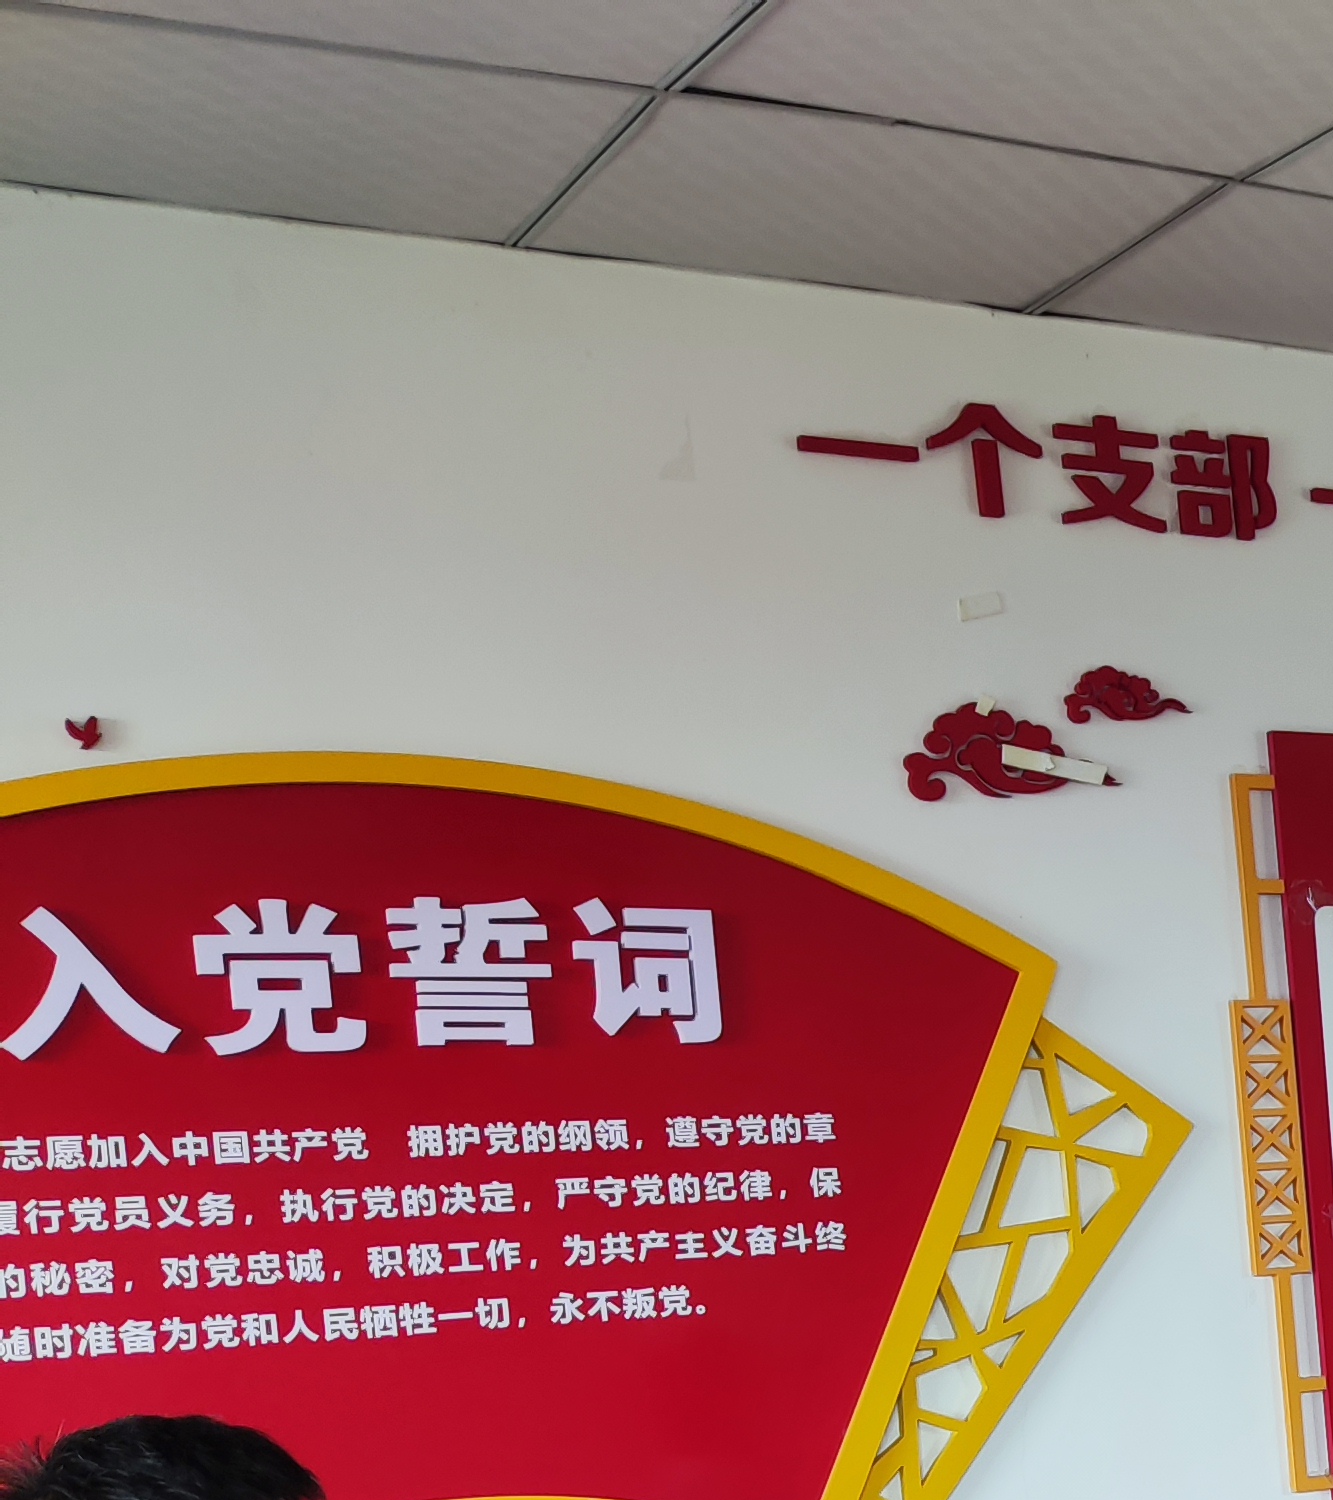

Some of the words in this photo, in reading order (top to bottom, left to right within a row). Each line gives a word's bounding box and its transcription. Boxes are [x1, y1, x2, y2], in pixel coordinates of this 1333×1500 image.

[797, 402, 1279, 541] 一个支部
[0, 897, 723, 1061] 入党誓词
